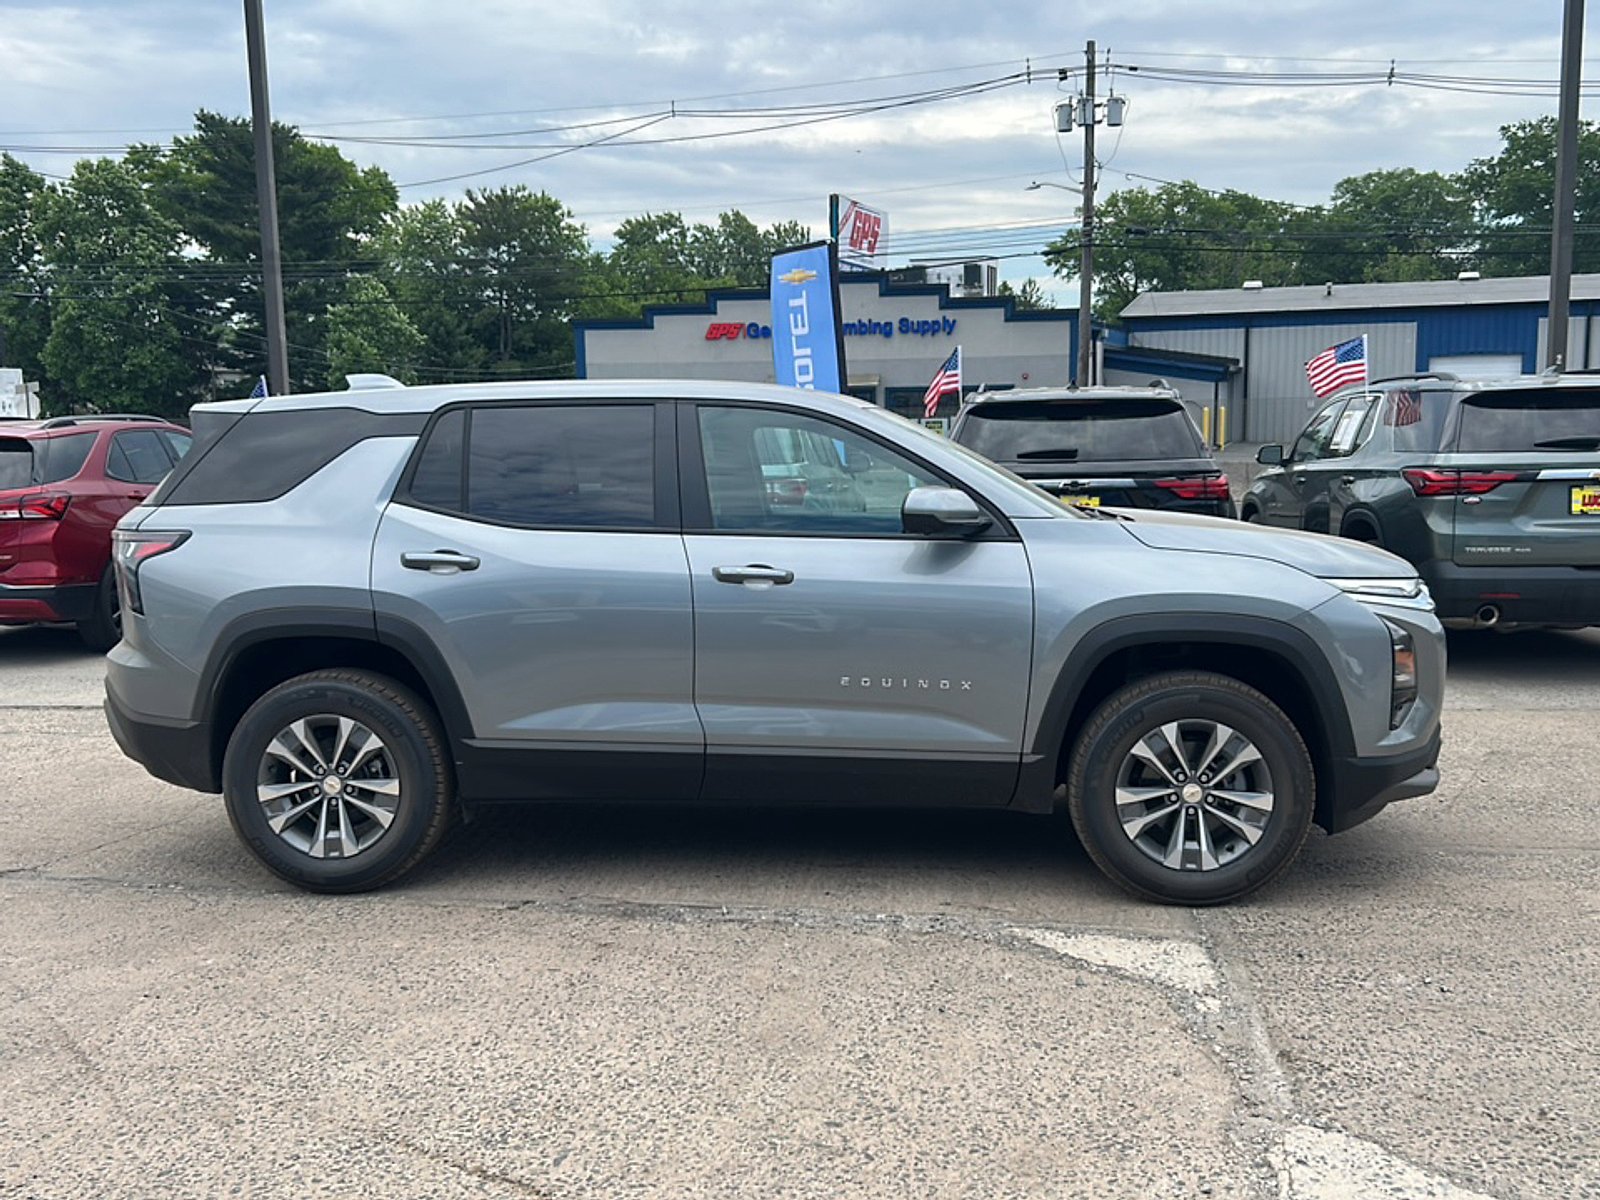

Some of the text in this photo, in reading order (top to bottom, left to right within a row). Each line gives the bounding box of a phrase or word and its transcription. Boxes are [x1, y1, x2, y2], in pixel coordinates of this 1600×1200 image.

[849, 210, 881, 253] GPS
[705, 315, 957, 341] GPS Ge mbing Supply
[840, 676, 972, 690] EQUINOX
